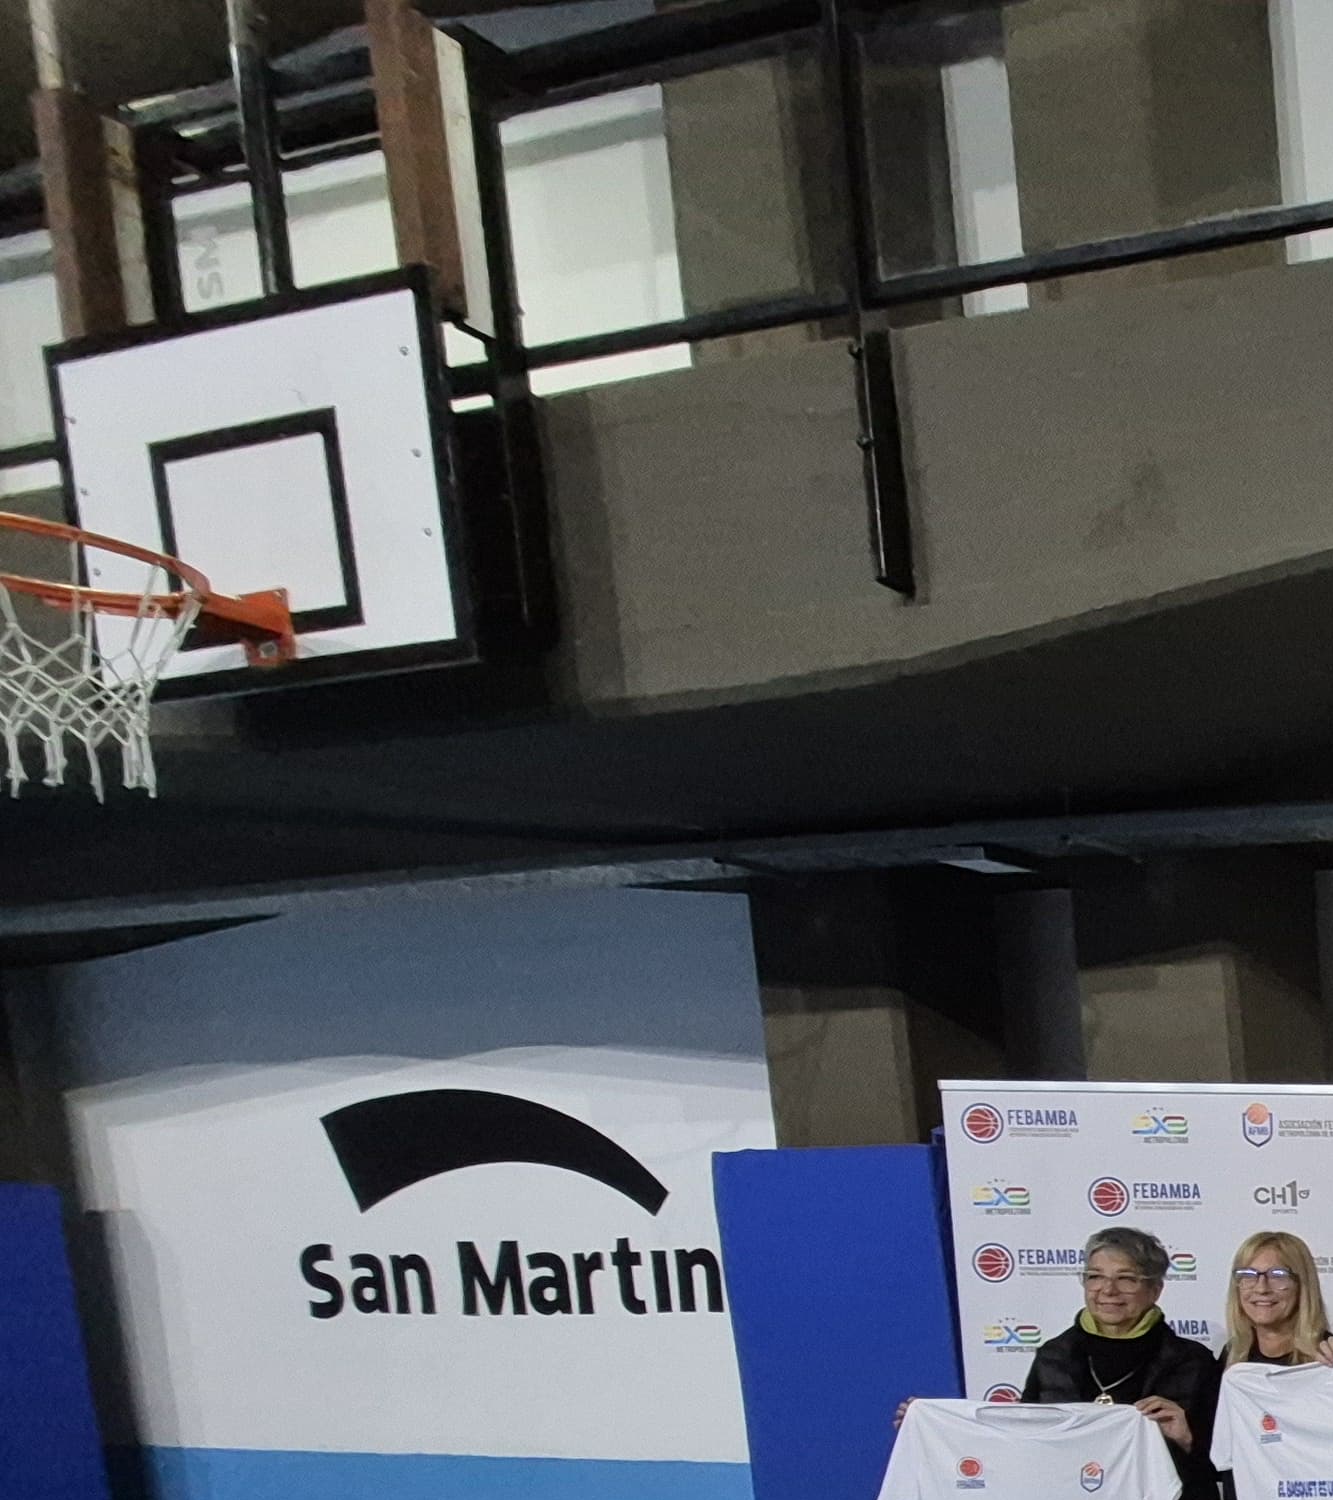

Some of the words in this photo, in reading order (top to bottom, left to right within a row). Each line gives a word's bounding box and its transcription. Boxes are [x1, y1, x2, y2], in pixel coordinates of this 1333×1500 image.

[1007, 1109, 1078, 1126] FEBAMBA
[1248, 1126, 1269, 1136] AFMB
[1133, 1183, 1201, 1199] FEBAMBA
[300, 1243, 436, 1319] San
[1278, 1480, 1286, 1497] EL
[1287, 1481, 1317, 1498] BASQUET
